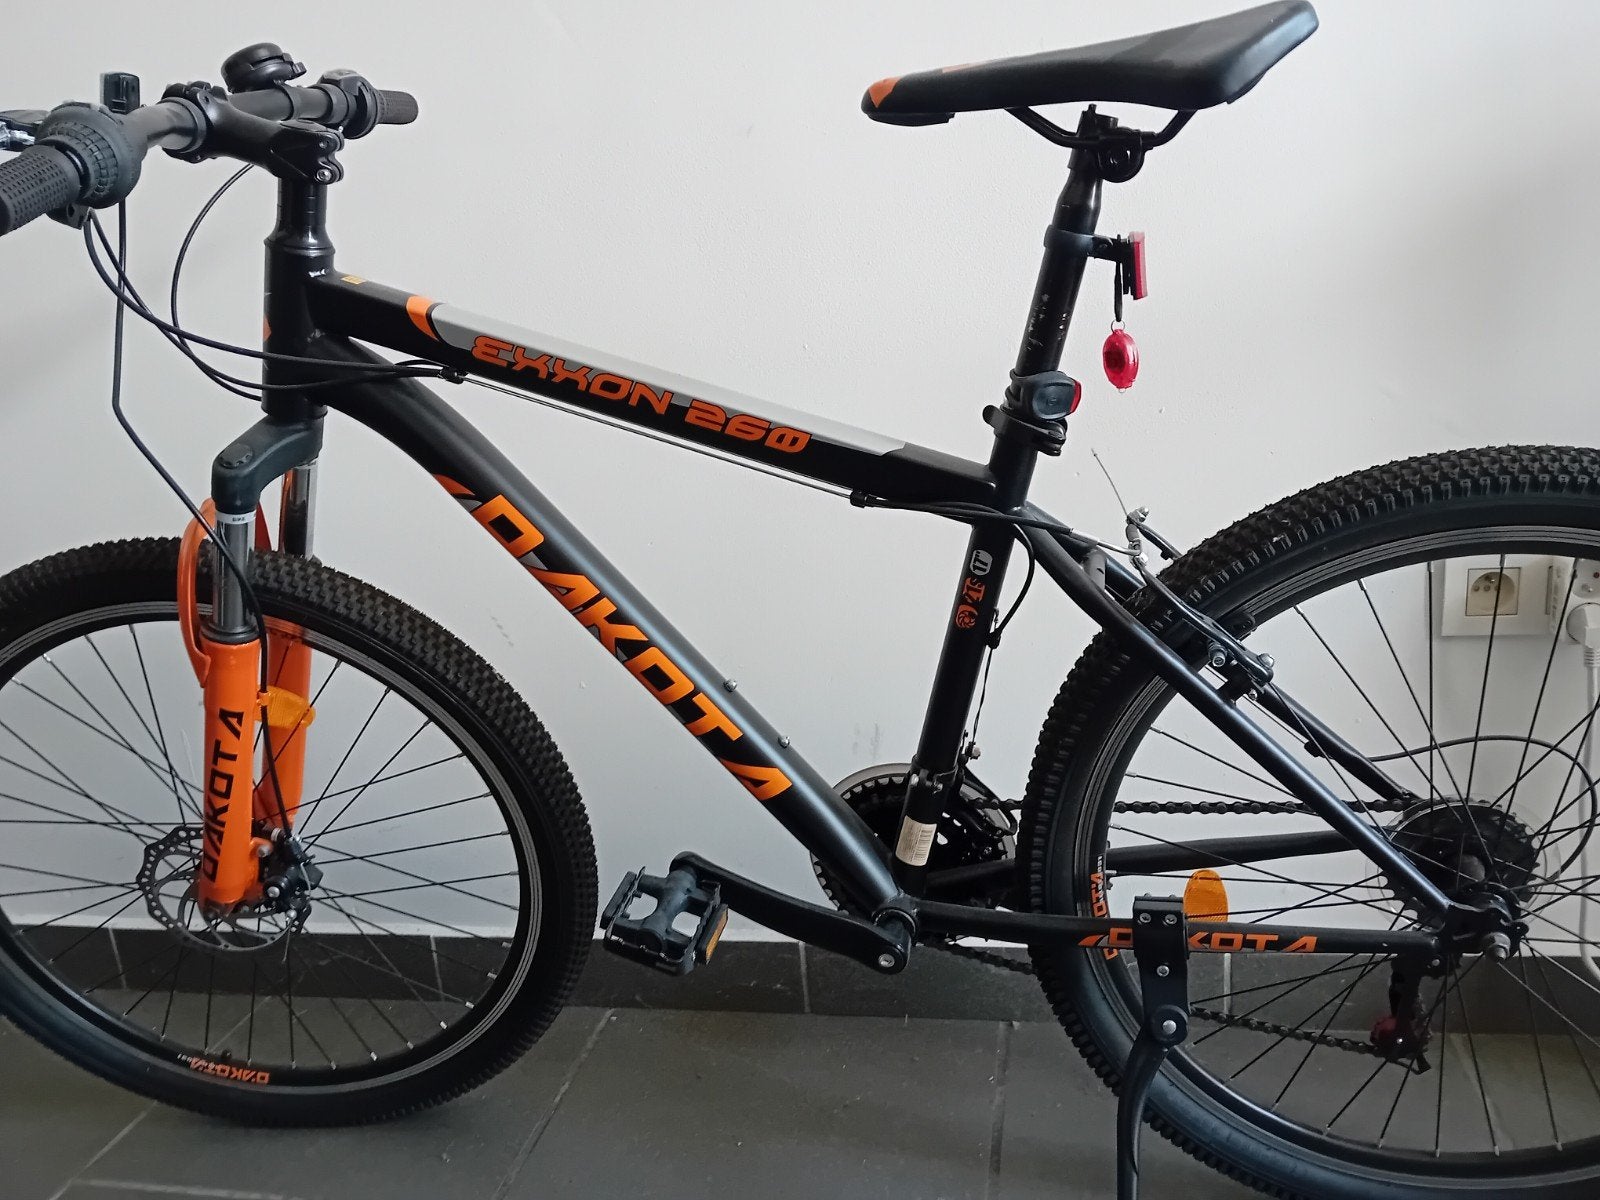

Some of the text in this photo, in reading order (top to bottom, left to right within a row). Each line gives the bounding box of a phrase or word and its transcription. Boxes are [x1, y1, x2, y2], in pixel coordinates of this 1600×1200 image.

[470, 334, 675, 417] EXXON
[470, 493, 794, 801] DAKOTA
[202, 706, 245, 883] DAKOTA
[1108, 927, 1319, 953] DKOTA
[189, 1056, 271, 1085] DAKOTA
